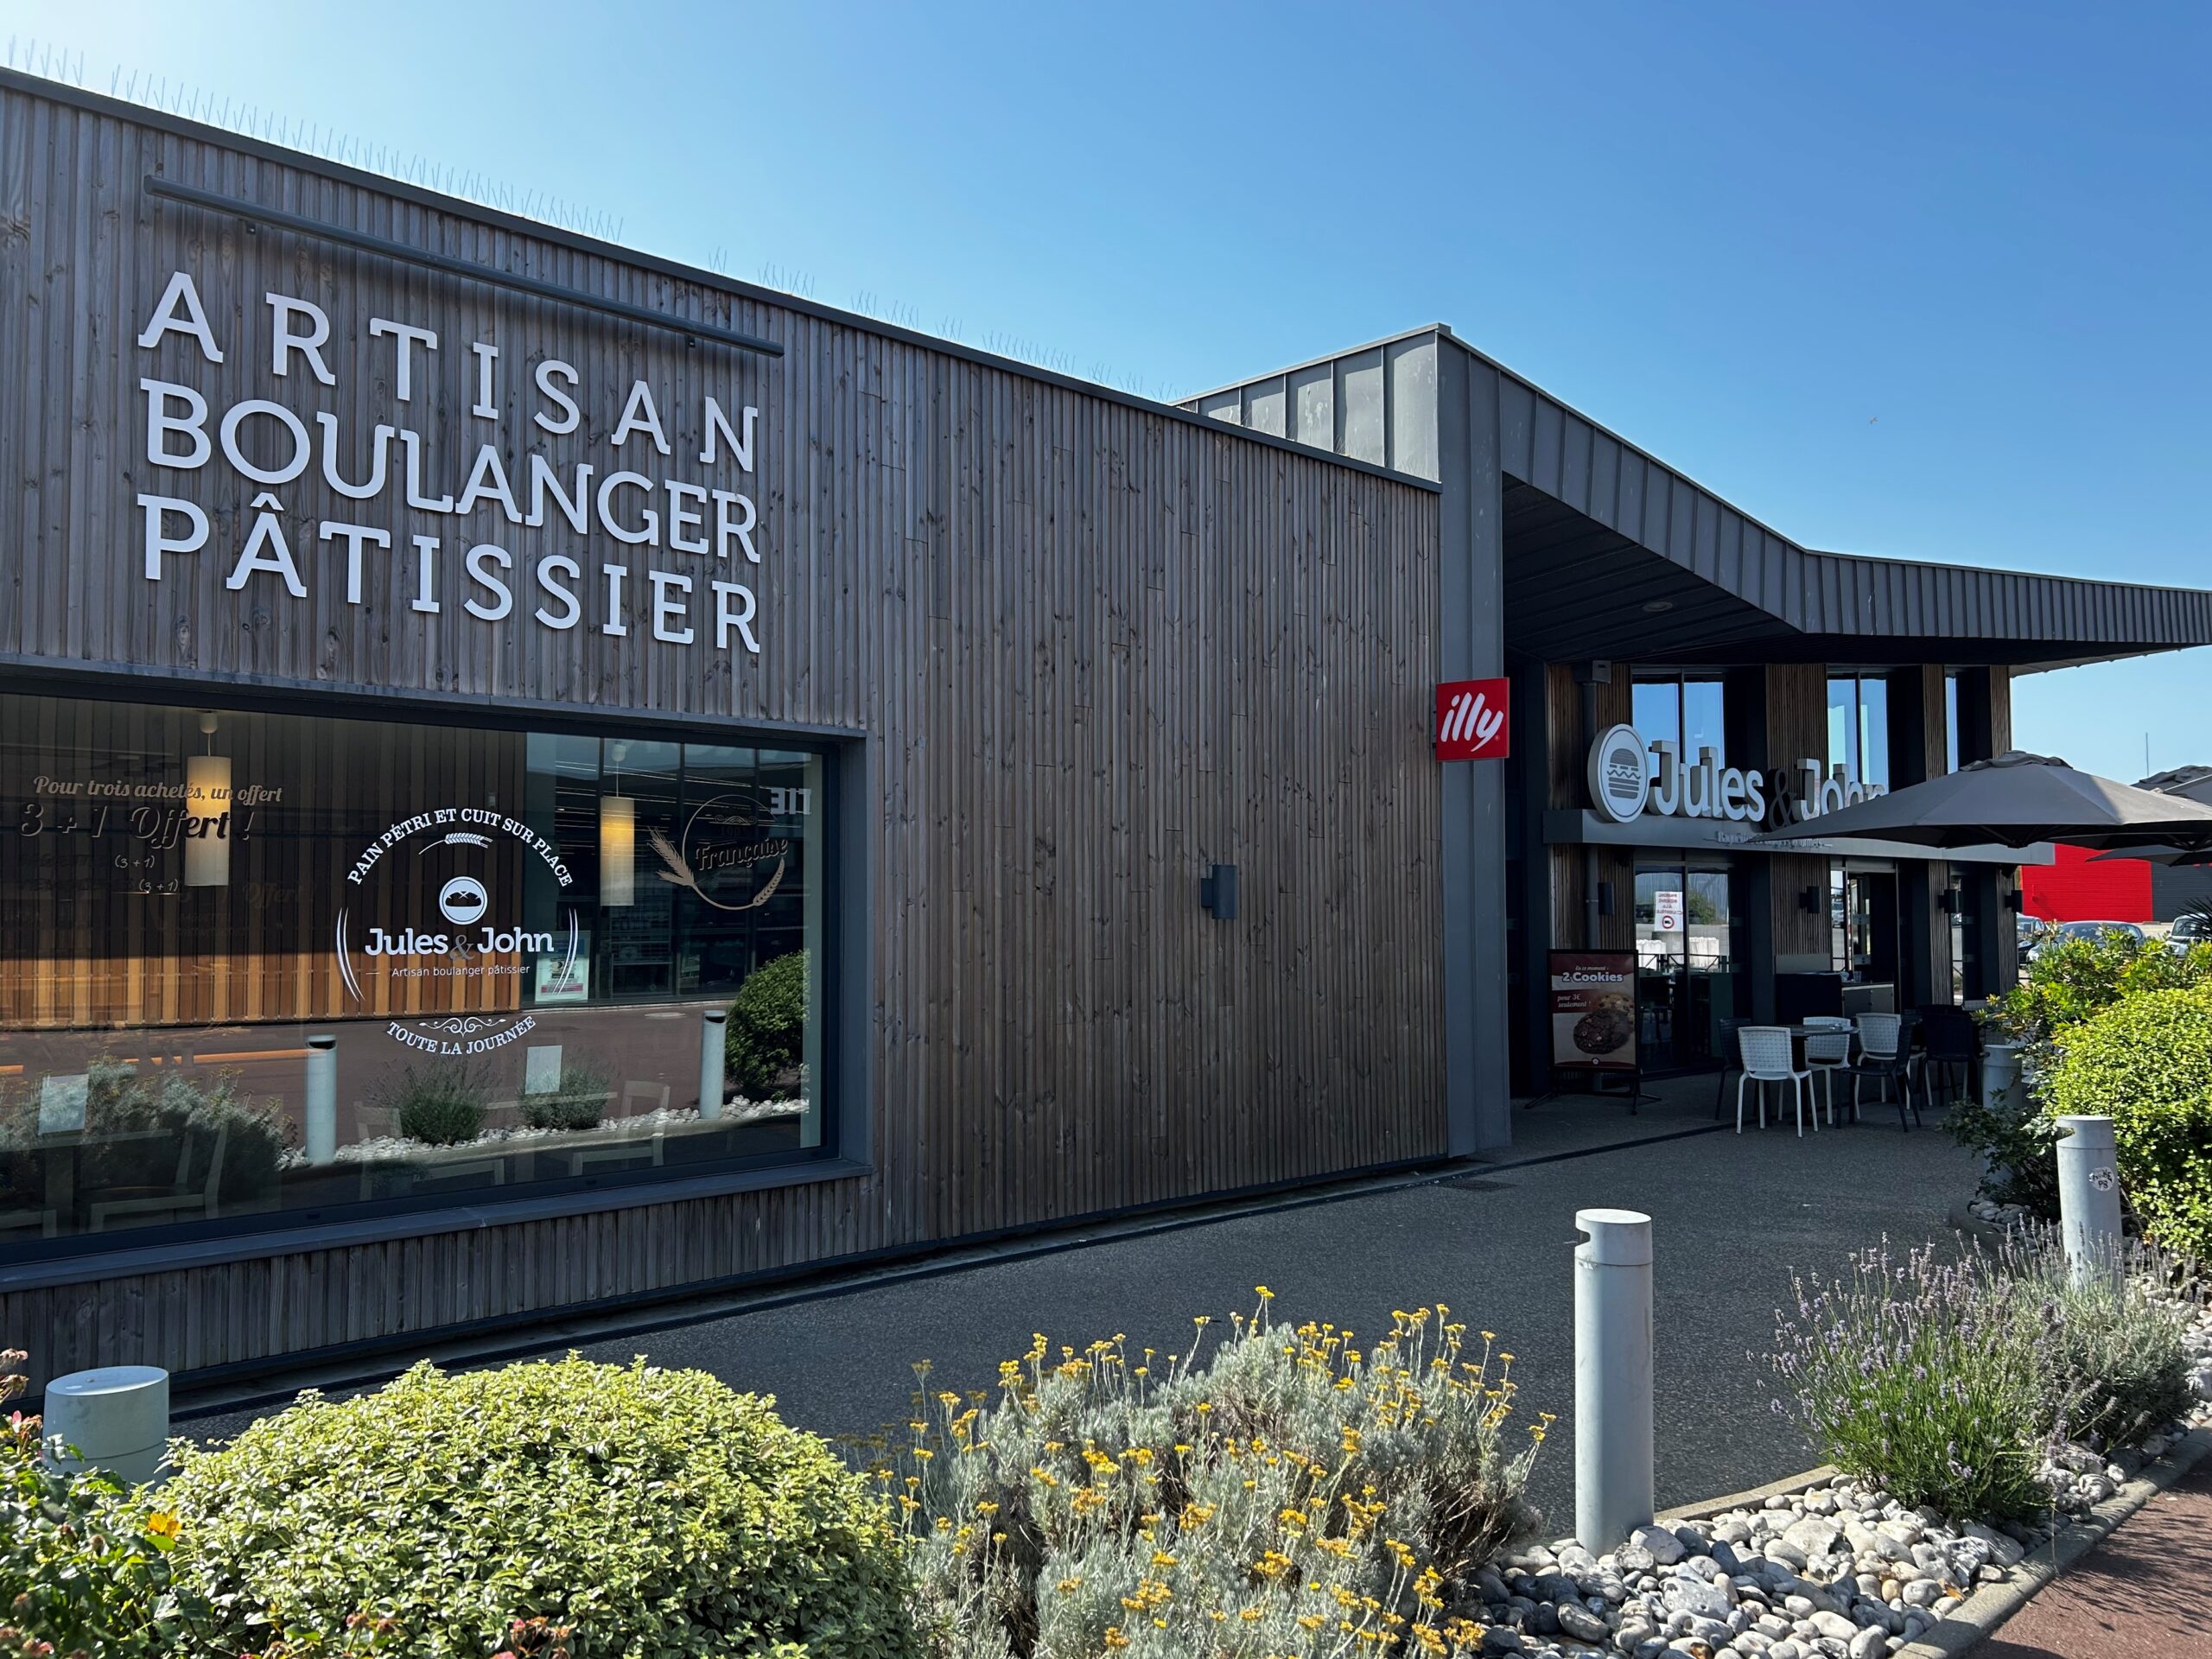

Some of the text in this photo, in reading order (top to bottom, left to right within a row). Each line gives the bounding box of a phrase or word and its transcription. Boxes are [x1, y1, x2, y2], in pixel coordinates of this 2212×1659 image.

[138, 271, 759, 474] ARTISAN
[140, 378, 760, 563] BOULANGER
[137, 493, 760, 653] PÂTISSIER
[1440, 691, 1504, 753] illy
[34, 775, 283, 805] Pour trois achetés, un offert
[1648, 740, 1765, 822] Jules
[1768, 767, 1798, 832] &
[347, 807, 574, 887] PAIN PÉTRI ET CUIT SUR PLACE
[365, 928, 448, 956] Jules
[449, 934, 475, 961] &
[477, 926, 554, 955] John
[391, 964, 531, 977] Artisan boulanger pâtissier
[1562, 971, 1624, 982] 2 Cookies
[386, 1014, 537, 1055] TOUTE LA JOURNÉE
